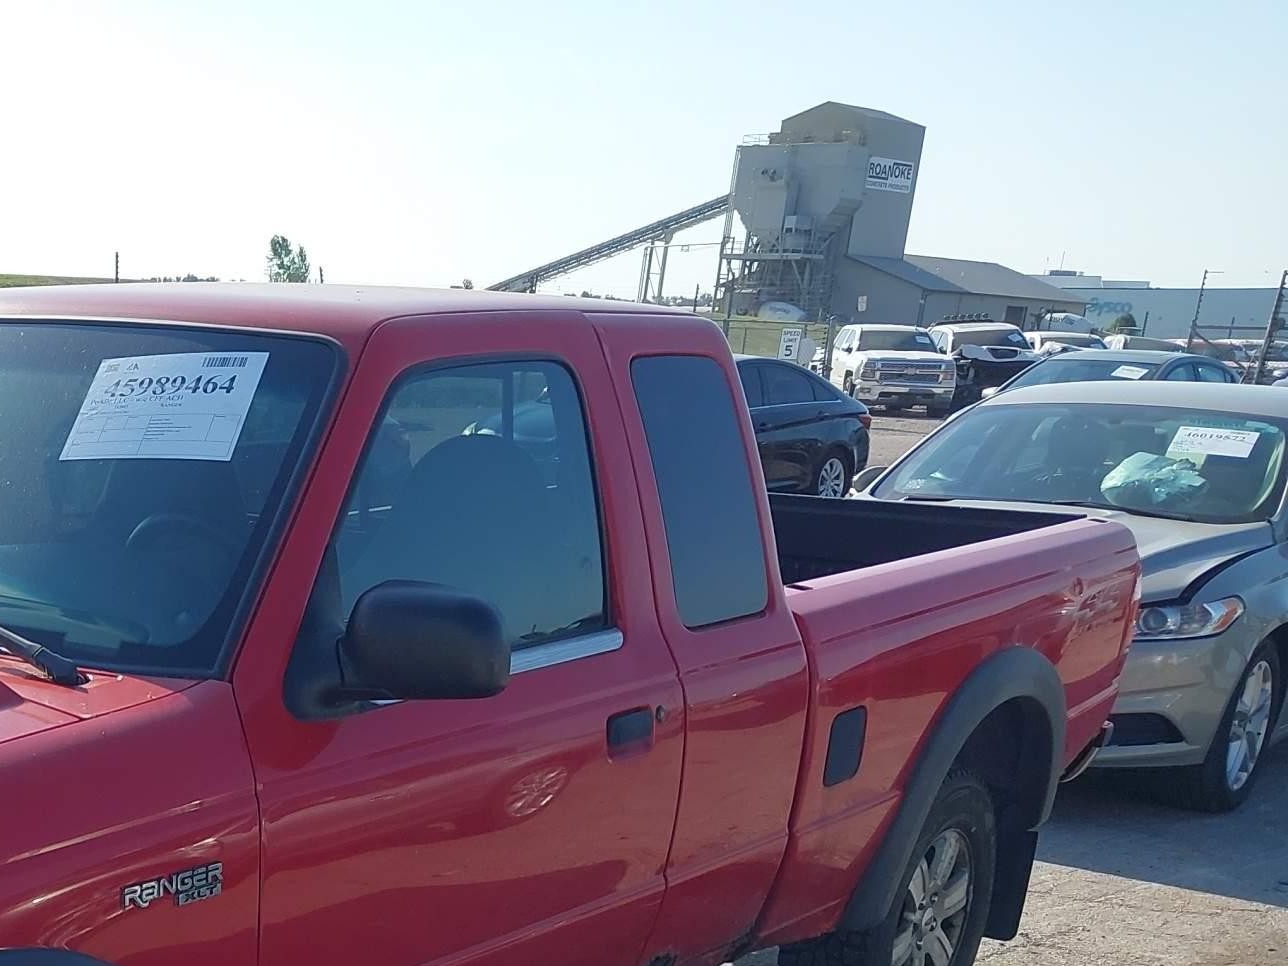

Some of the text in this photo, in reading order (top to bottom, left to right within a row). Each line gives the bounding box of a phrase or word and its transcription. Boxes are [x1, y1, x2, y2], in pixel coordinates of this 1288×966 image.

[868, 162, 913, 180] ROANOKE
[1086, 297, 1132, 316] Sysco
[784, 344, 793, 357] 5
[103, 374, 238, 398] 45989464
[181, 885, 219, 904] XLT
